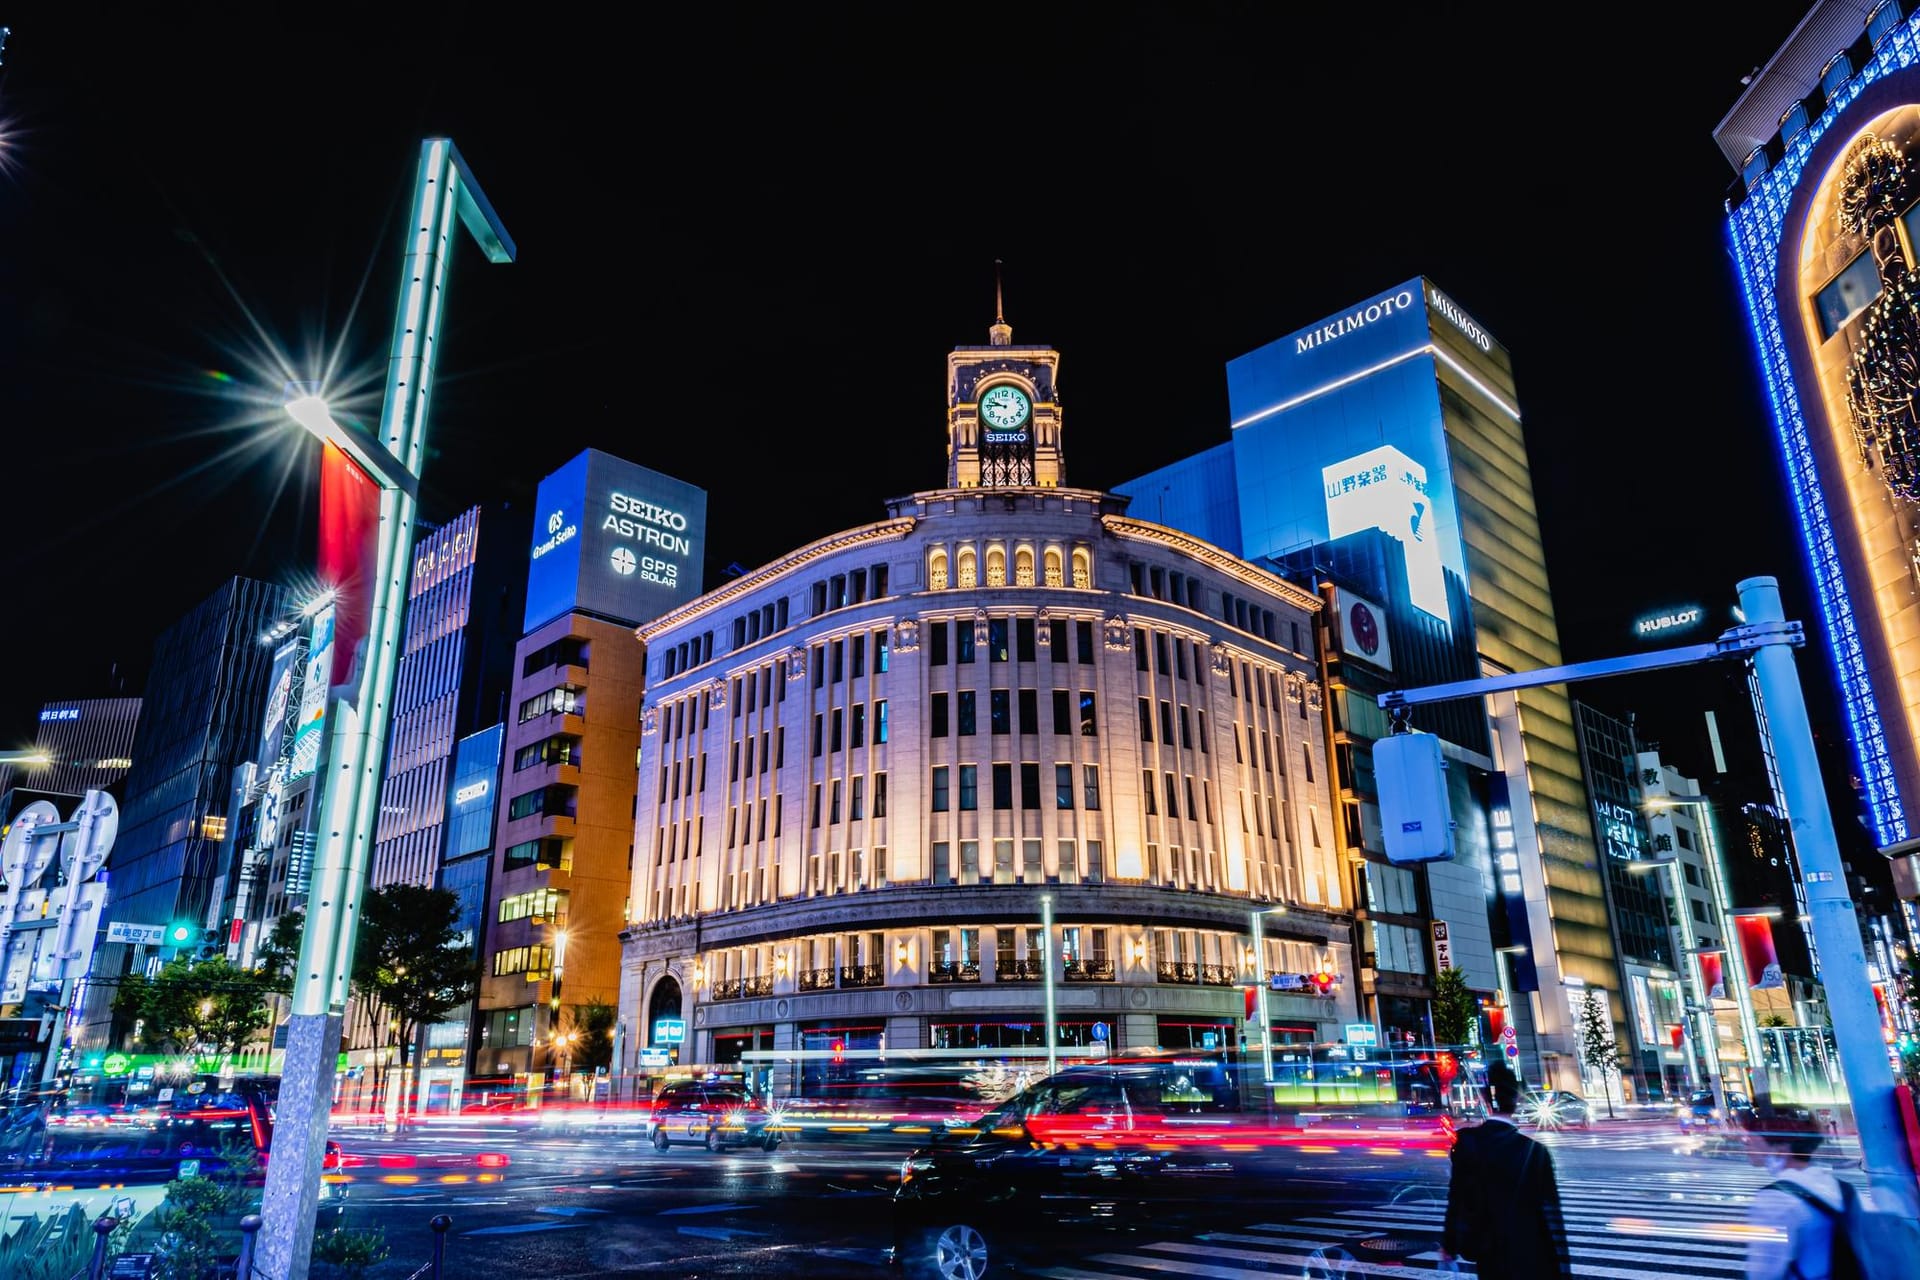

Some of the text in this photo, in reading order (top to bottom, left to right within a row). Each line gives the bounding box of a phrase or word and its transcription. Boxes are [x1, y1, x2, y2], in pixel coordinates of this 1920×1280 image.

[1296, 292, 1412, 354] MIKIMOTO
[1431, 290, 1490, 351] MIKIMOTO
[986, 433, 1026, 442] SEIKO
[1327, 464, 1387, 498] 山野楽器
[548, 510, 564, 534] GS
[610, 492, 687, 532] SEIKO
[533, 525, 577, 559] Grand Seiko
[602, 514, 690, 556] ASTRON
[641, 556, 678, 578] GPS
[641, 570, 677, 588] SOLAR
[1640, 610, 1698, 633] HUBLOT
